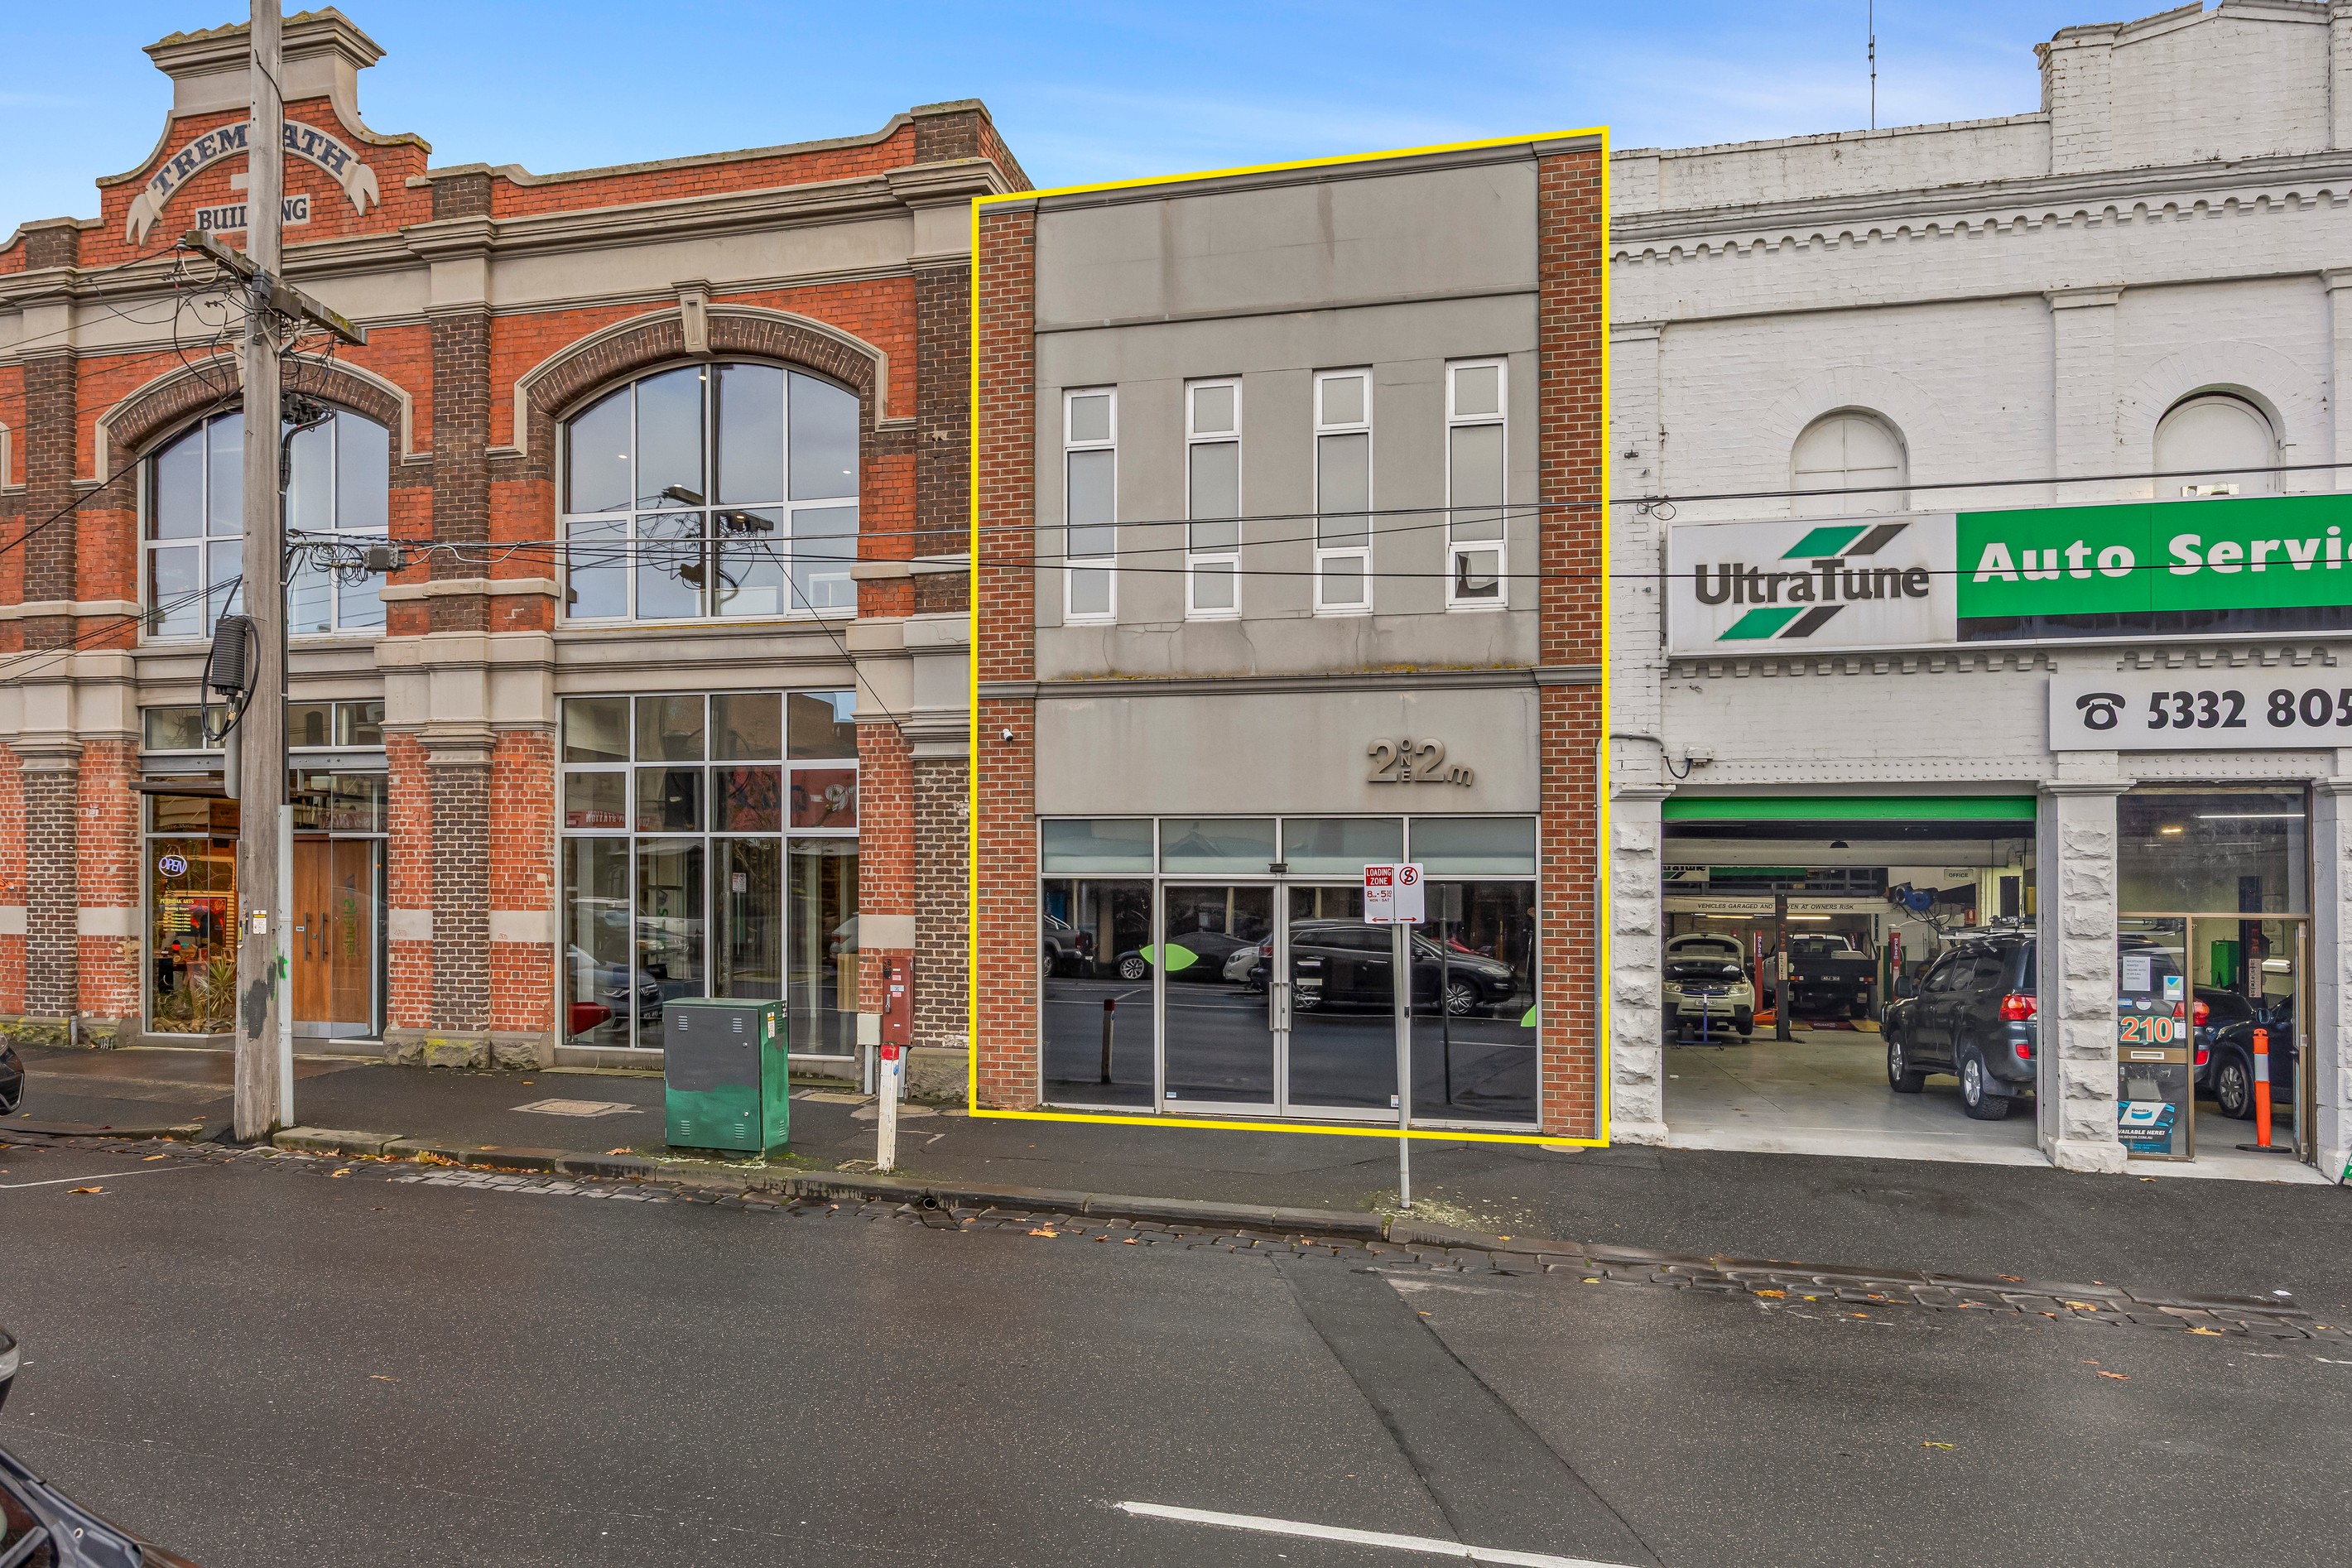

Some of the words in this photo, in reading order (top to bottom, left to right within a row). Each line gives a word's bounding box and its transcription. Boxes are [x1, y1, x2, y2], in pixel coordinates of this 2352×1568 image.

[151, 123, 352, 196] TREMATH
[197, 197, 307, 231] BUILNG
[1972, 540, 2135, 583] Auto
[2168, 526, 2352, 575] Servi
[1695, 559, 1930, 605] UltraTune
[2148, 690, 2247, 729] 5332
[2267, 688, 2352, 728] 805
[160, 858, 185, 873] OPEN
[2119, 1016, 2173, 1043] 210
